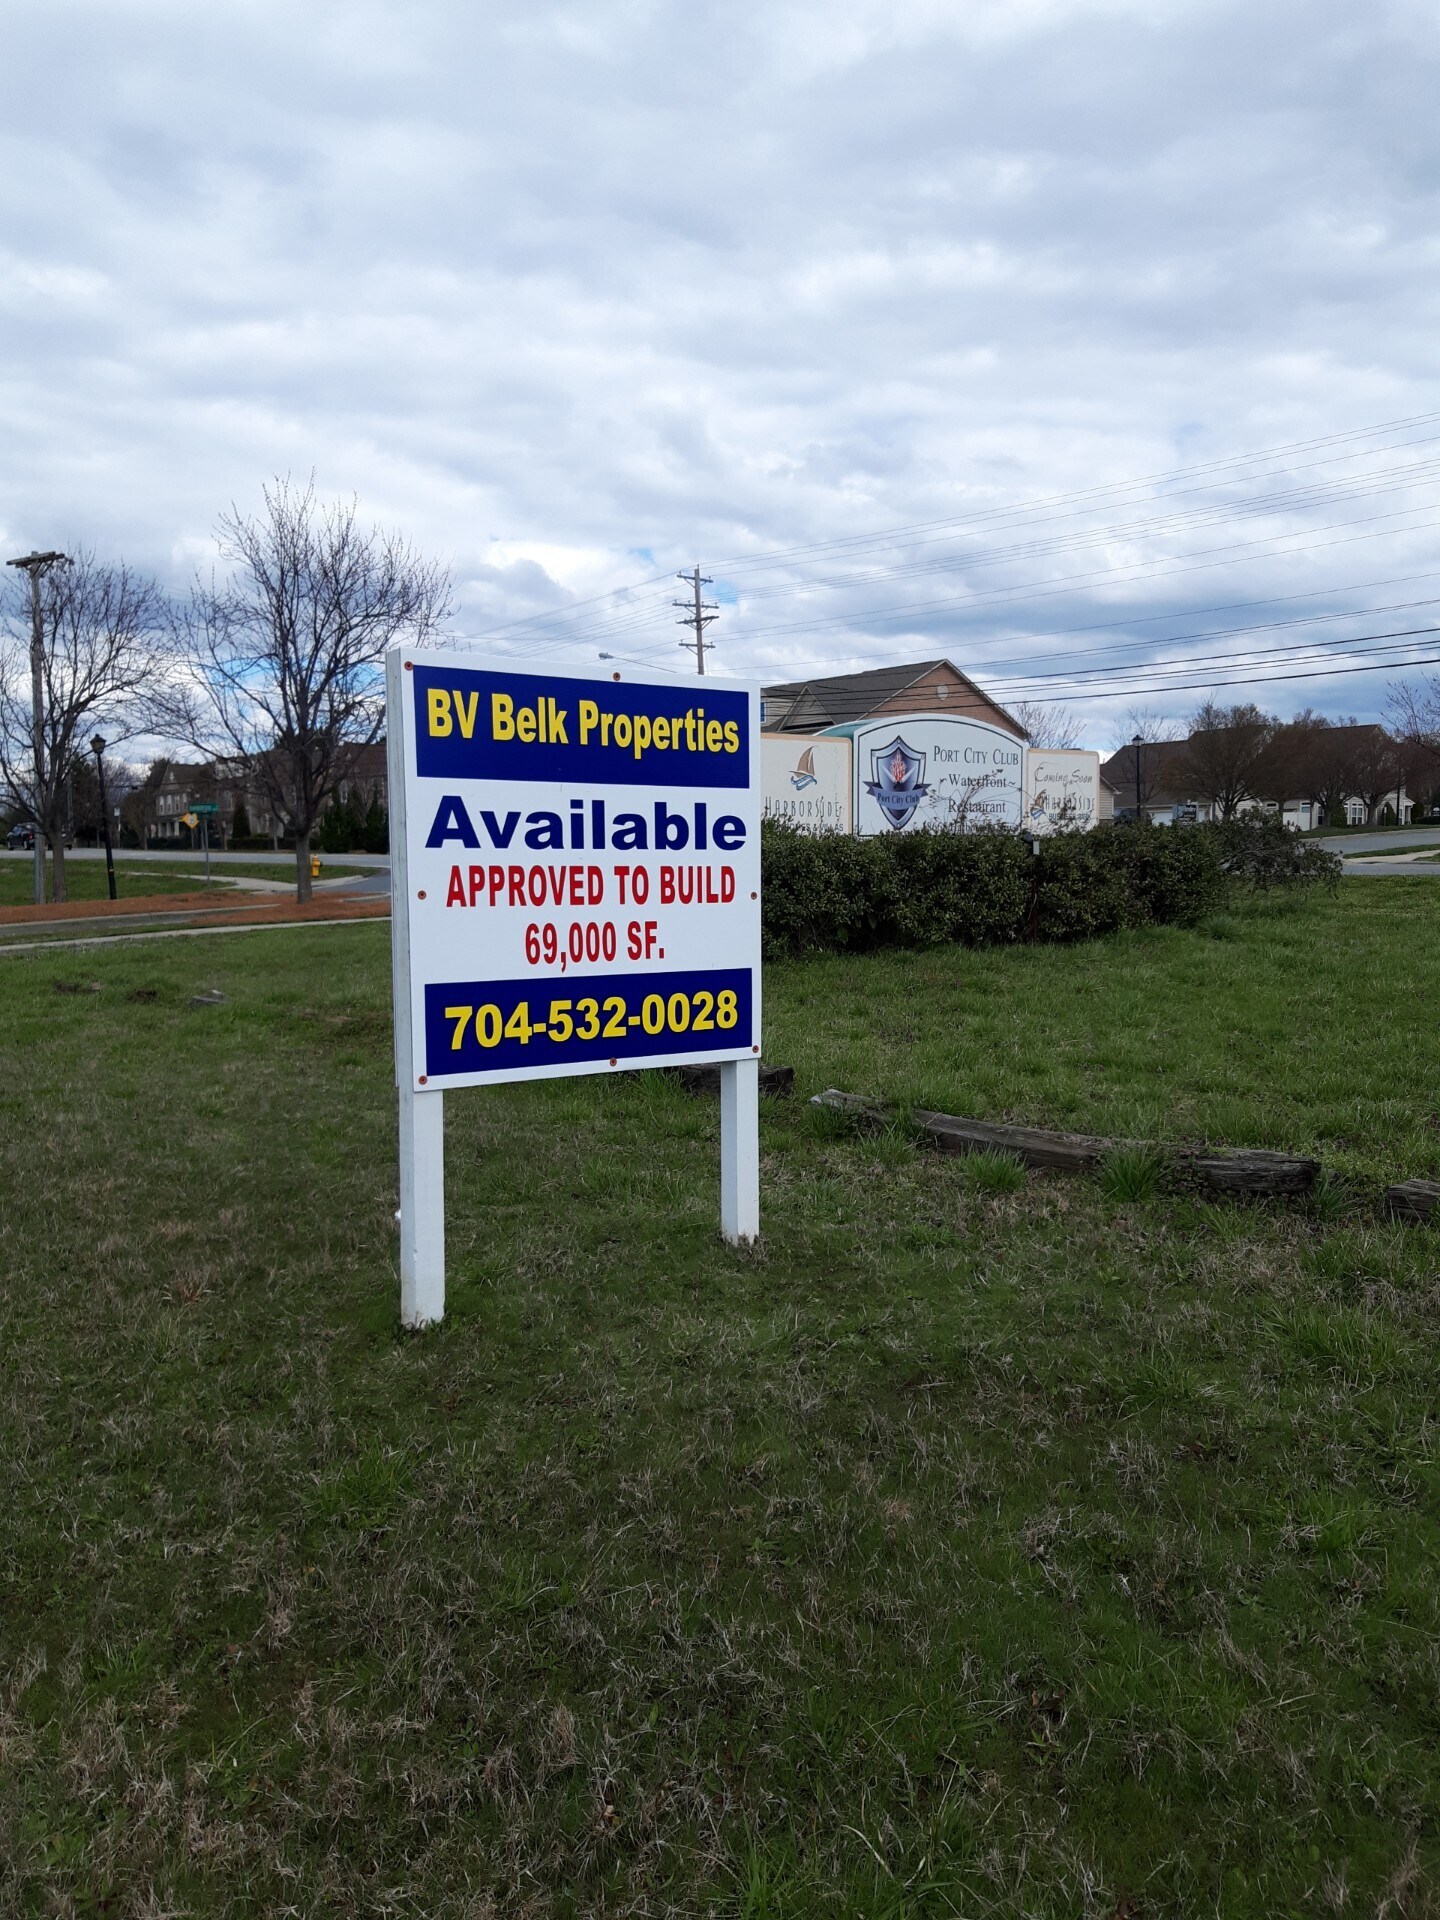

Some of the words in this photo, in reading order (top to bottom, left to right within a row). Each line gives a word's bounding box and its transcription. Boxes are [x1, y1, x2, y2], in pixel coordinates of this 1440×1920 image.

[427, 688, 479, 739] BV
[491, 693, 569, 744] Belk
[579, 699, 740, 760] Properties
[1071, 769, 1093, 783] Soon
[425, 795, 746, 851] Available
[446, 865, 604, 908] APPROVED
[614, 865, 649, 905] TO
[660, 866, 736, 904] BUILD
[525, 921, 617, 973] 69,000
[627, 921, 665, 960] SF.
[445, 989, 738, 1051] 704-532-0028
